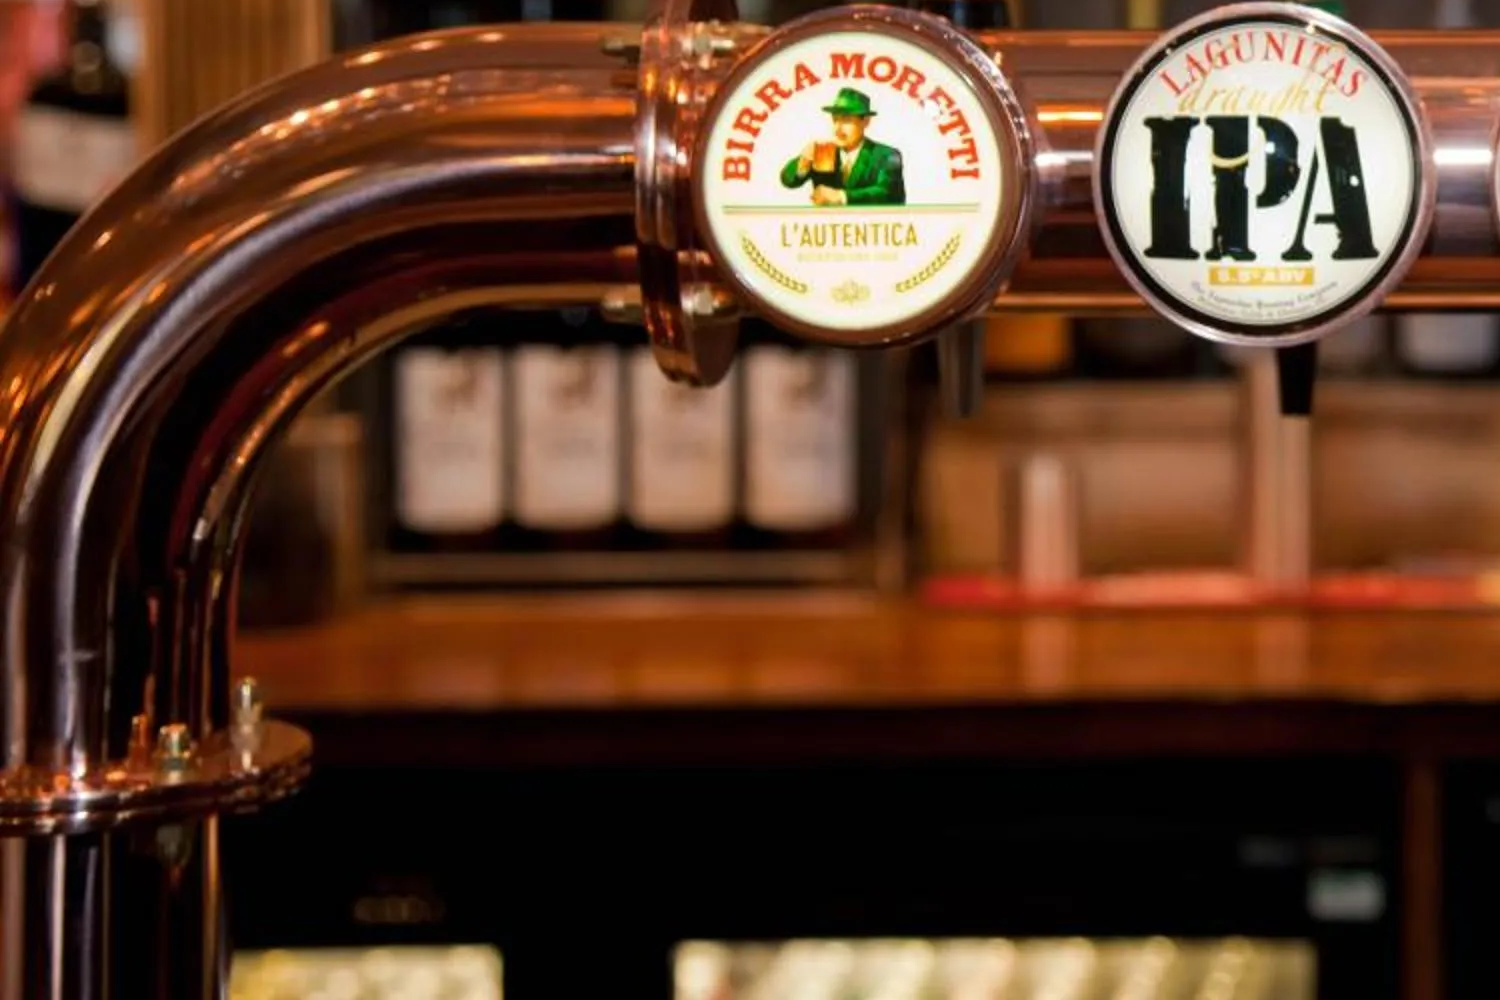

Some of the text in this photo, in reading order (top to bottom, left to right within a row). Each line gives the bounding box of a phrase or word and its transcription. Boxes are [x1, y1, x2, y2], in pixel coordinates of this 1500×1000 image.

[1159, 29, 1368, 98] LAGUNITAS
[722, 62, 821, 182] BIRRA
[780, 221, 918, 248] L'AUTENTICA
[1143, 115, 1381, 262] IPA
